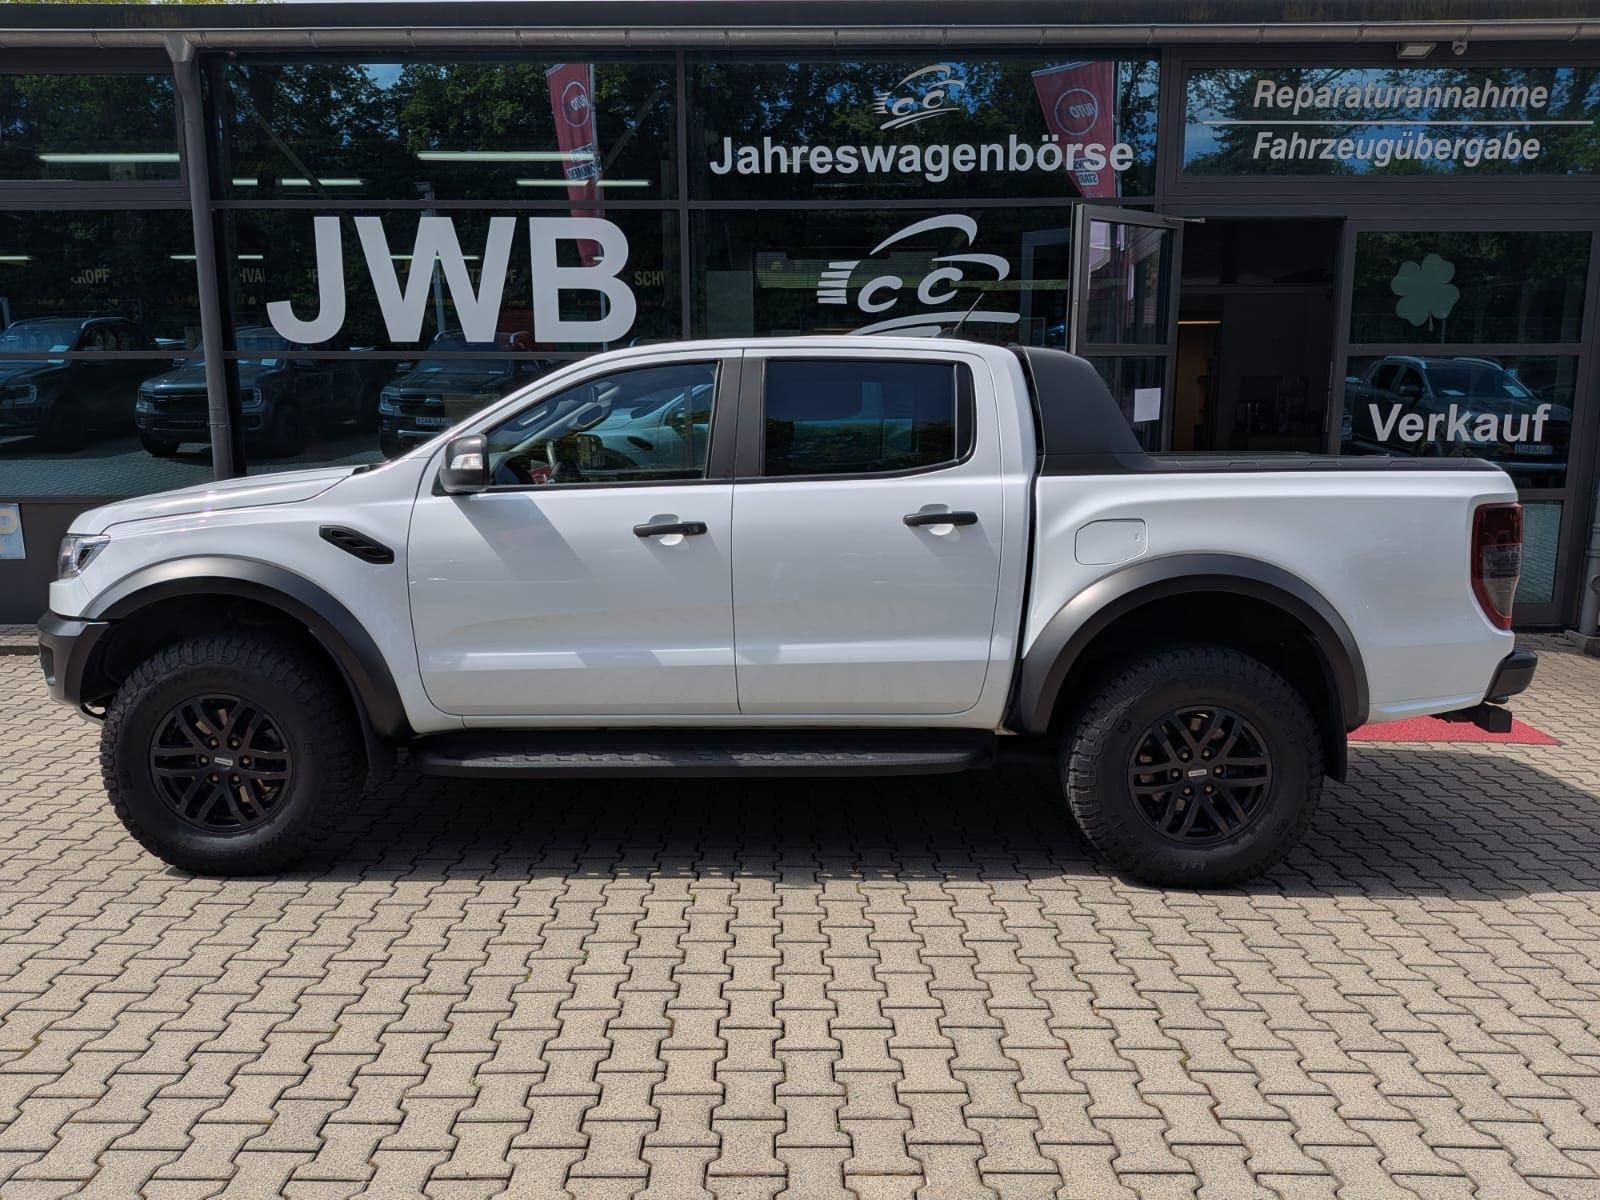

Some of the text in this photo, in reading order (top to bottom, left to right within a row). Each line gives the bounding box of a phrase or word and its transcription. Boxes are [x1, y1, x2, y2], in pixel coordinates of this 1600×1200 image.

[1253, 80, 1548, 116] Reparaturannahme
[710, 134, 1134, 183] Jahreswagenbörse
[1253, 131, 1540, 168] Fahrzeugübergabe
[267, 216, 637, 343] JWB
[1369, 403, 1552, 442] Verkauf
